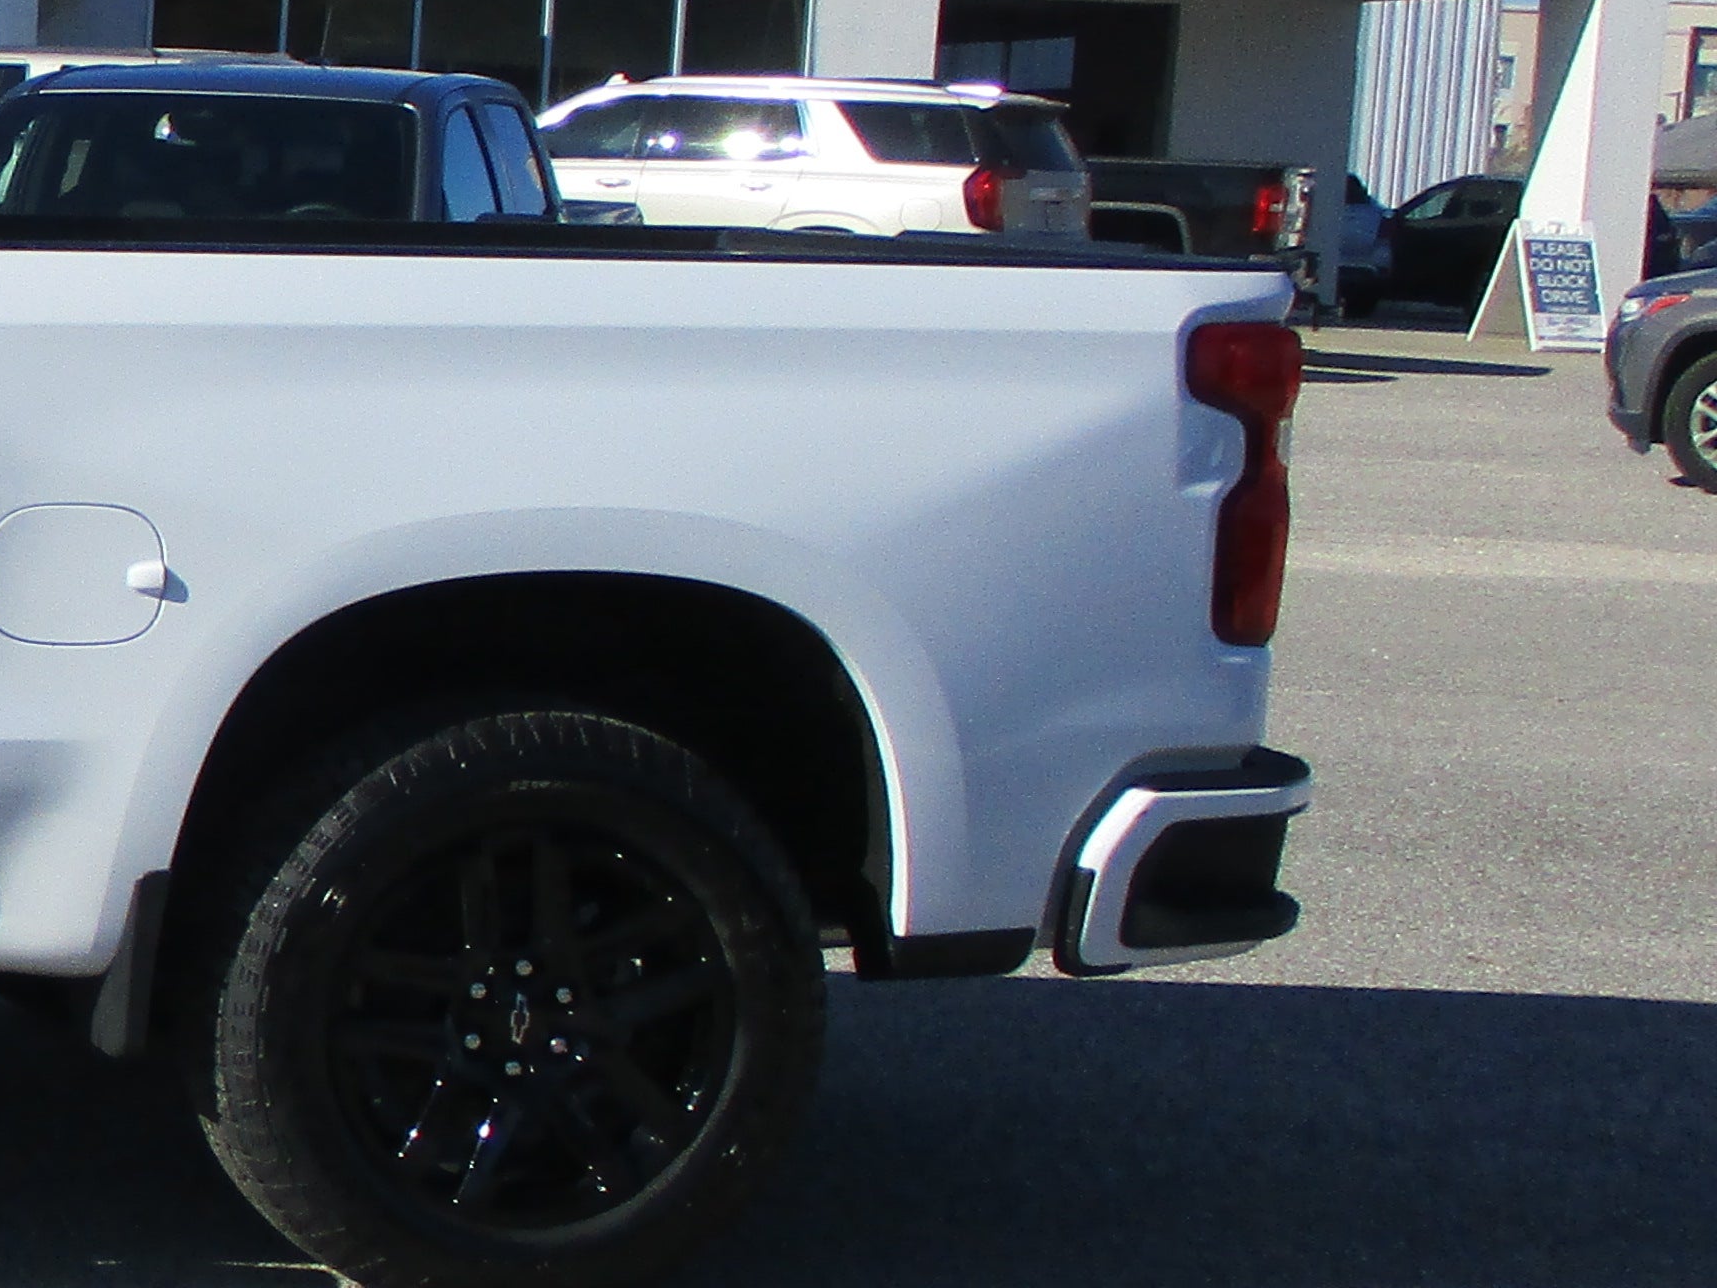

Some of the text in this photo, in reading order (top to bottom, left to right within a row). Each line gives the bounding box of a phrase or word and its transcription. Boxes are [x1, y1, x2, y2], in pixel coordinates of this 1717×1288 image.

[1530, 258, 1594, 273] DO NOT
[1536, 274, 1588, 288] BLOCK
